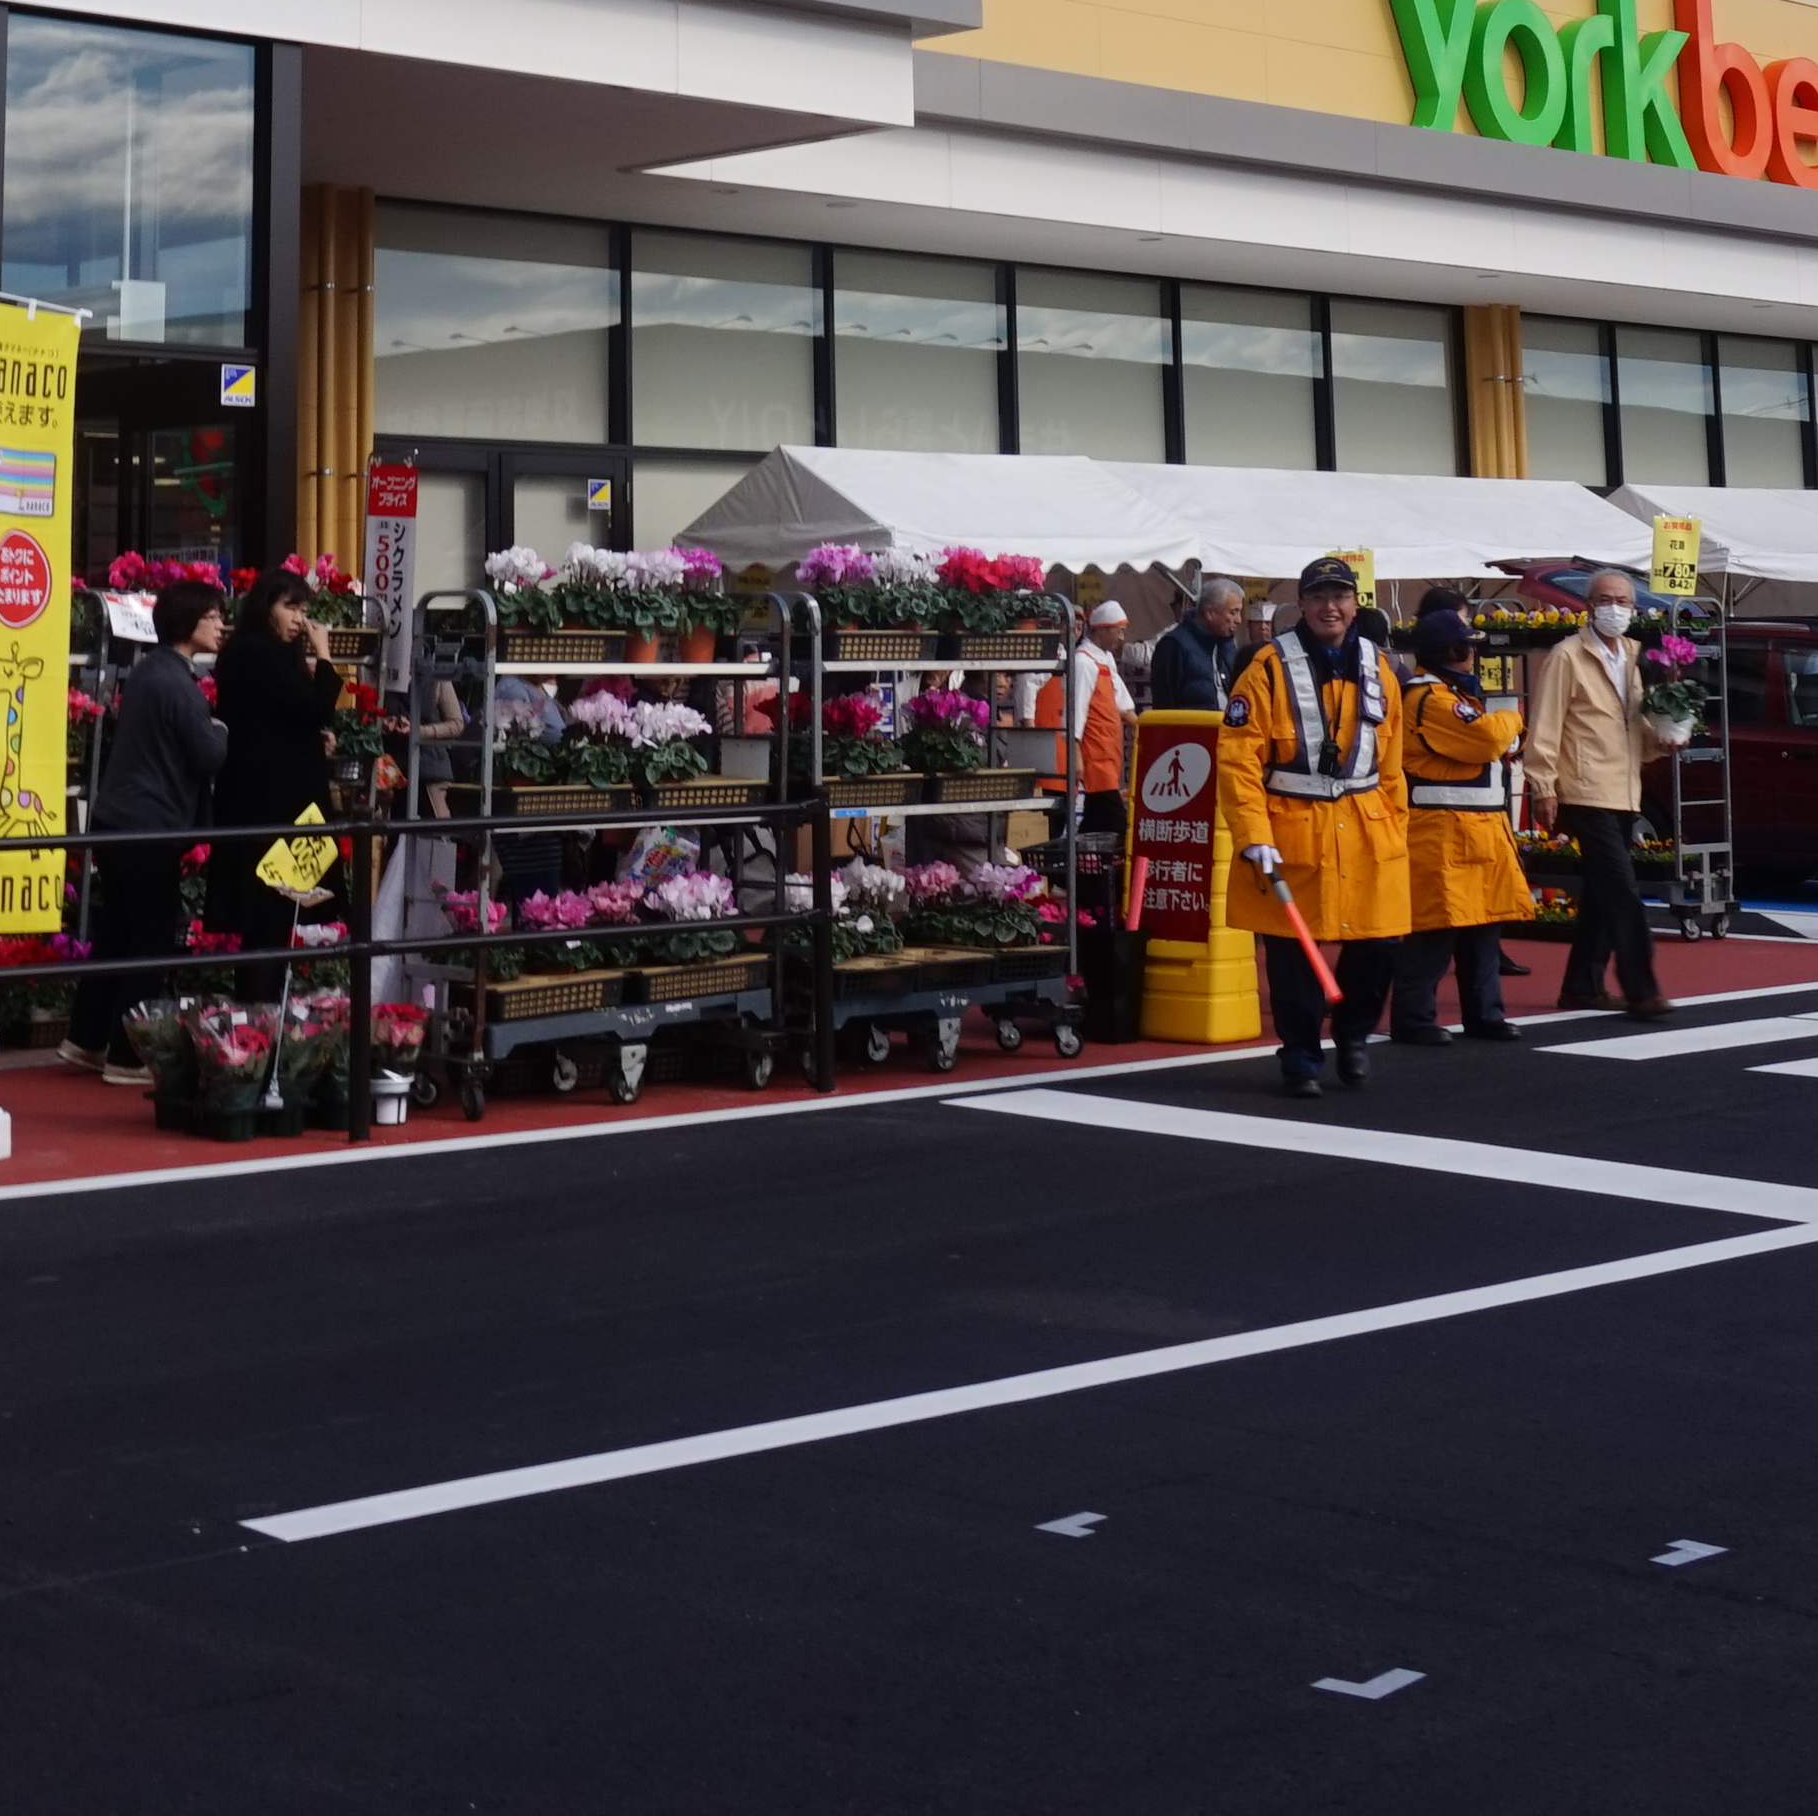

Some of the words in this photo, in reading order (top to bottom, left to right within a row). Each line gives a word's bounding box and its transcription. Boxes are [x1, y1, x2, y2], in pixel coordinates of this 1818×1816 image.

[390, 522, 406, 639] シクラメン
[1138, 818, 1209, 844] 横断歩道
